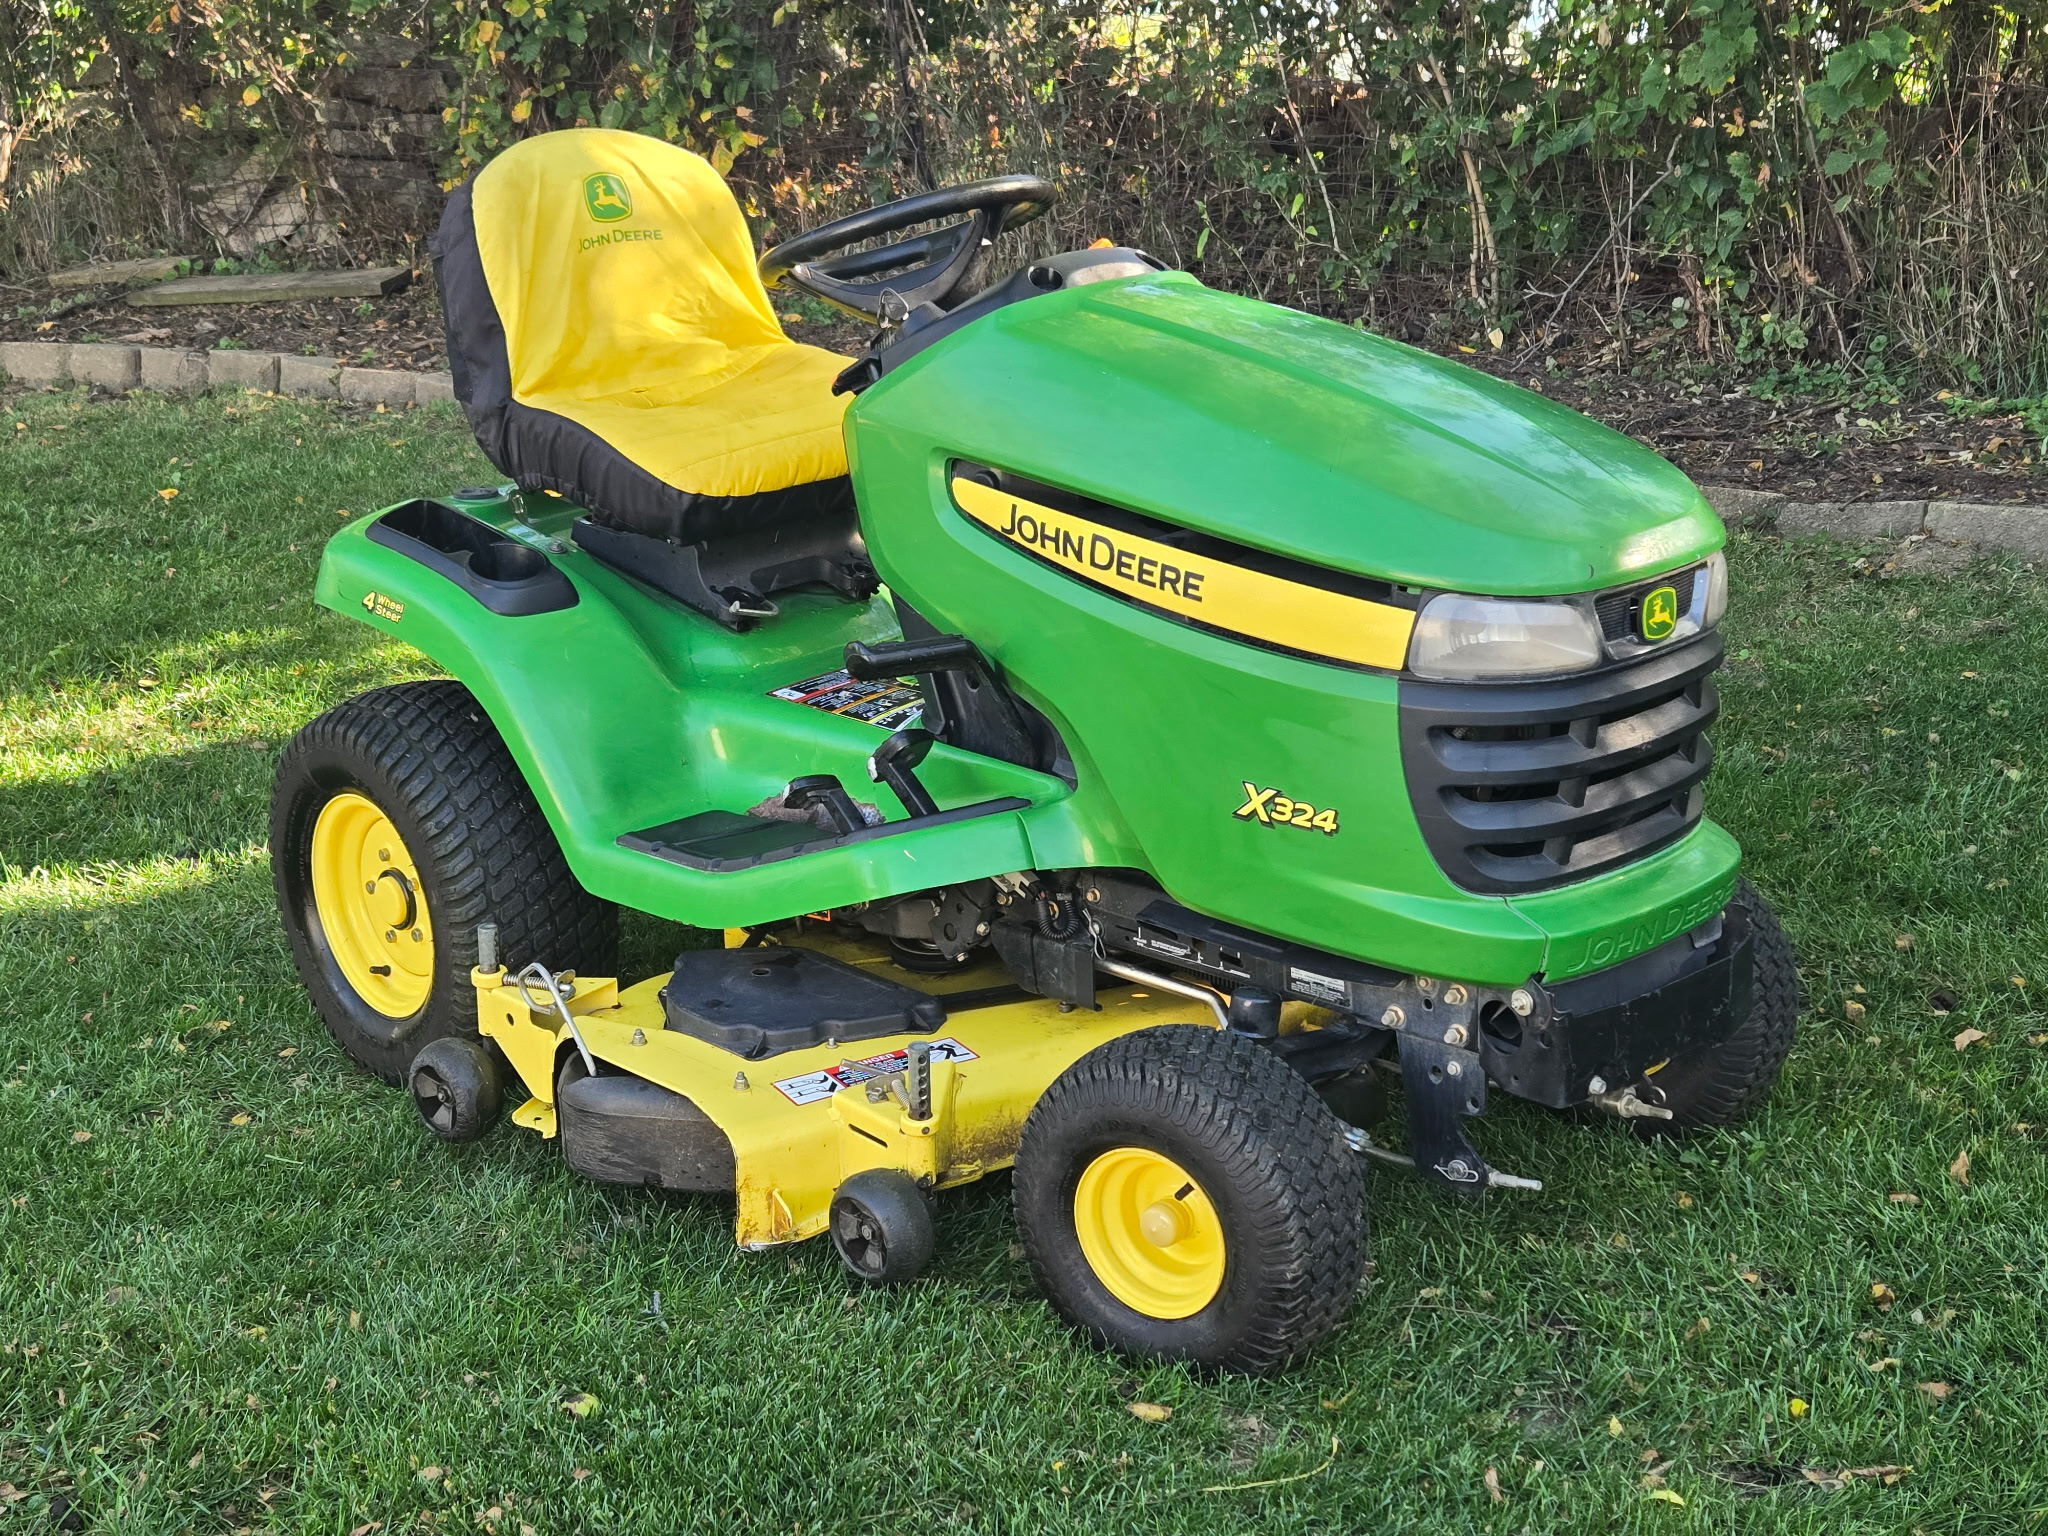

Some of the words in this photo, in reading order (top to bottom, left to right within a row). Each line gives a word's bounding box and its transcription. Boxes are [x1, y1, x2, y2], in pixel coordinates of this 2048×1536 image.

[577, 233, 611, 253] JOHN
[612, 229, 663, 243] DEERE
[1000, 503, 1084, 563] JOHN
[1089, 533, 1205, 603] DEERE
[362, 590, 376, 613] 4
[377, 593, 405, 613] Wheel
[375, 604, 402, 623] Steer
[1232, 780, 1339, 836] X324
[1566, 919, 1659, 973] JOHN
[1661, 879, 1737, 940] DEERE
